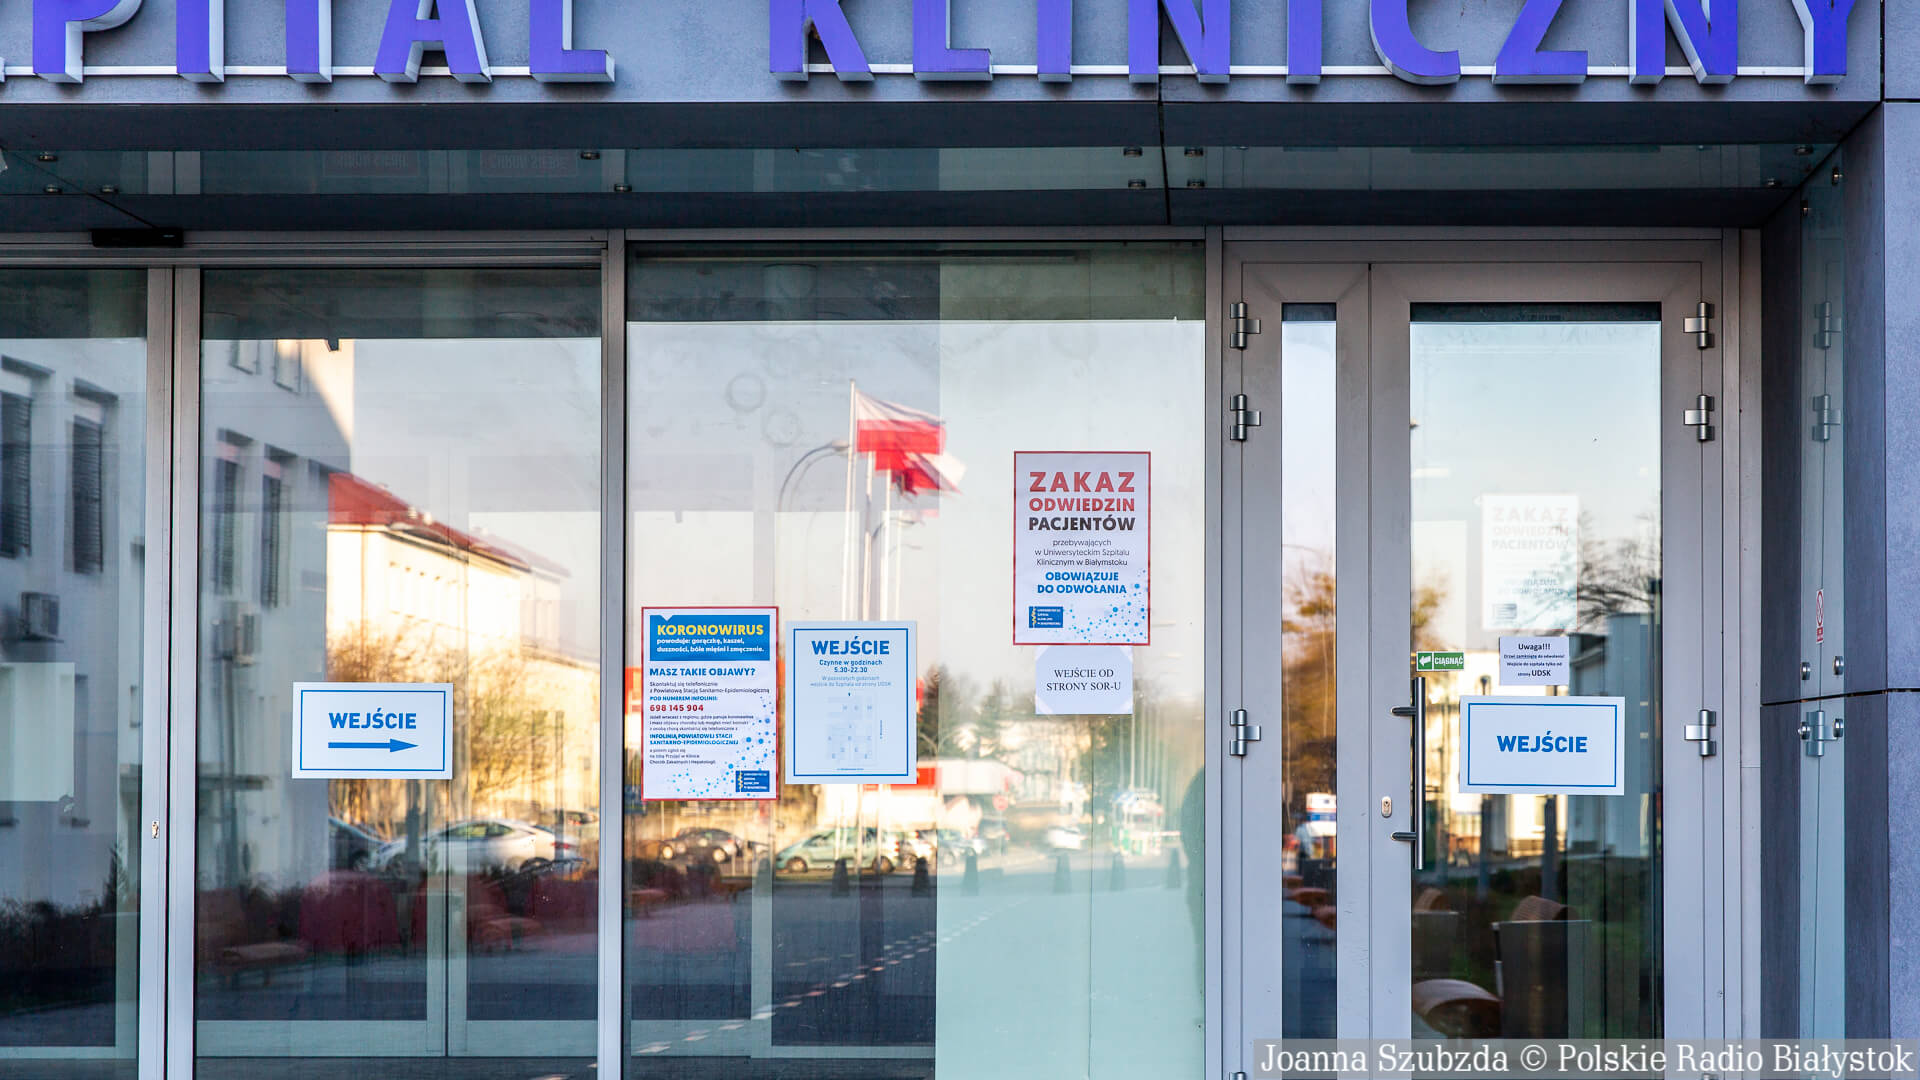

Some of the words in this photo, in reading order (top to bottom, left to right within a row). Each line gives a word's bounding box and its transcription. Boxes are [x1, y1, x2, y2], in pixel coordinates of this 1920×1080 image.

[1029, 472, 1135, 492] ZAKAZ
[1029, 498, 1135, 512] ODWIEDZIN
[1493, 506, 1568, 522] ZAKAZ
[1029, 514, 1136, 530] PACJENTÓW
[1052, 539, 1112, 547] przebywających
[1044, 549, 1100, 557] Uniwersyteckim
[1045, 572, 1119, 583] OBOWIĄZUJE
[1037, 584, 1054, 594] DO
[1056, 584, 1127, 594] ODWOŁANIA
[657, 624, 764, 636] KORONOWIRUS
[812, 636, 890, 655] WEJŚCIE
[1518, 643, 1551, 651] Uwaga!!!
[650, 668, 678, 676] MASZ
[680, 668, 707, 676] TAKIE
[709, 668, 756, 676] OBJAWY?
[1054, 667, 1097, 678] WEJŚCIE
[1098, 669, 1114, 678] OD
[1046, 683, 1088, 691] STRONY
[1090, 682, 1121, 691] SOR-U
[650, 704, 667, 712] 698
[669, 704, 685, 712] 145
[687, 704, 704, 712] 904
[328, 707, 417, 729] WEJŚCIE
[1497, 731, 1588, 753] WEJŚCIE
